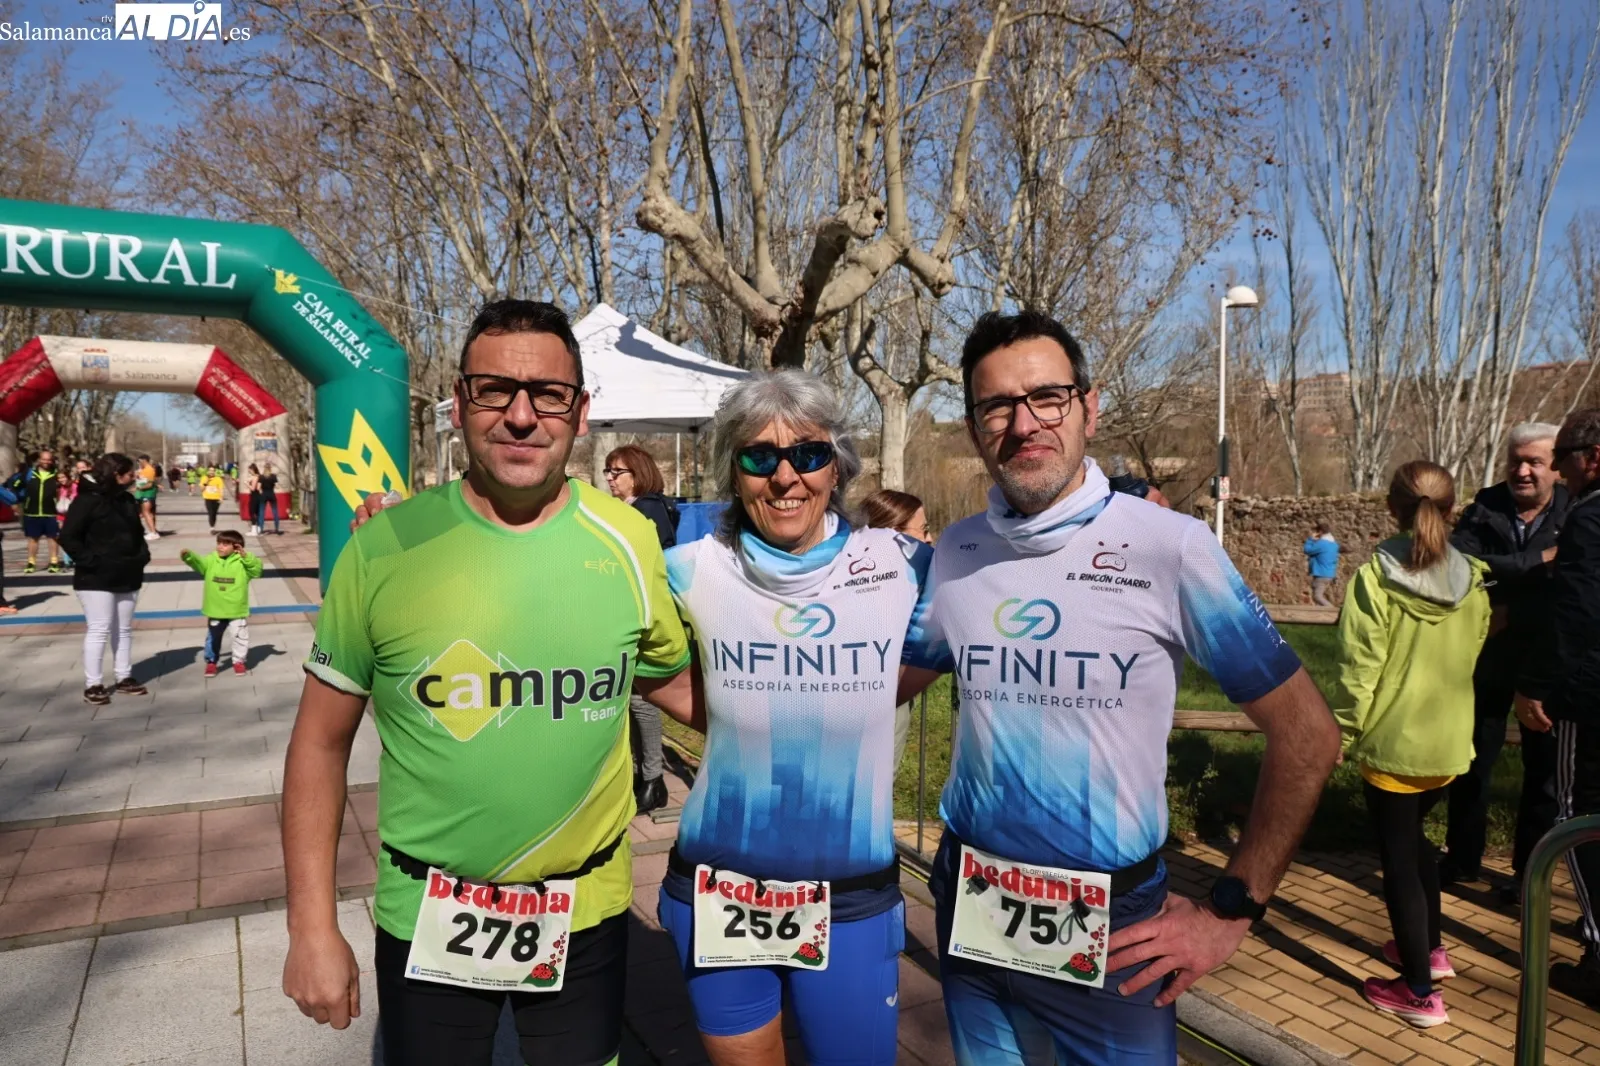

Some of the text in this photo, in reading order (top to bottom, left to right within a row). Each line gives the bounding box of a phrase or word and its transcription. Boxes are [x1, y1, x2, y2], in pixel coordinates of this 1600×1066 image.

[0, 223, 237, 290] RURAL
[292, 300, 362, 368] DE SALAMANCA
[303, 292, 372, 359] CAJA RURAL
[124, 370, 178, 381] Salamanca
[871, 570, 898, 583] CHARRO
[1066, 572, 1152, 590] EL RINCÓN CHARRO
[712, 638, 892, 676] INFINITY
[415, 651, 629, 721] campal
[722, 679, 885, 692] ASESORÍA ENERGÉTICA
[1017, 692, 1123, 709] ENERGÉTICA
[581, 706, 617, 723] Team
[428, 873, 571, 915] bedunia
[698, 870, 827, 908] bedunia
[963, 852, 1106, 908] bedunia
[446, 912, 540, 963] 278
[723, 904, 800, 940] 256
[1001, 895, 1058, 945] 75
[1406, 997, 1434, 1009] HOKA
